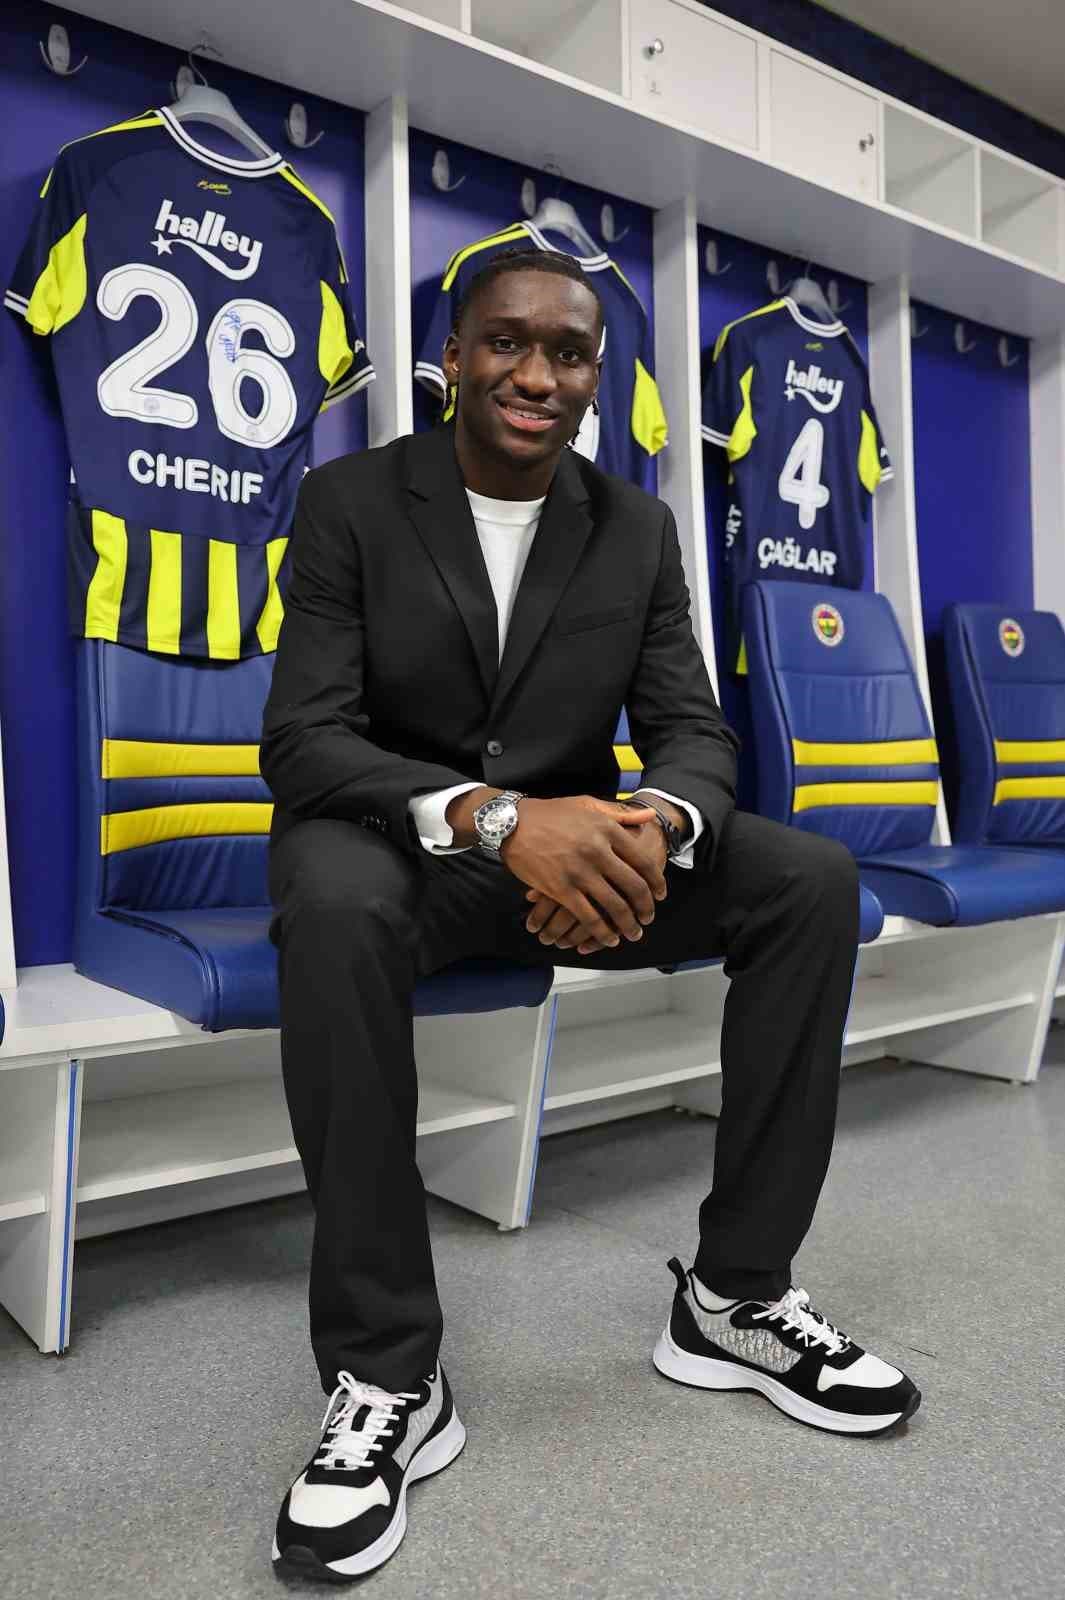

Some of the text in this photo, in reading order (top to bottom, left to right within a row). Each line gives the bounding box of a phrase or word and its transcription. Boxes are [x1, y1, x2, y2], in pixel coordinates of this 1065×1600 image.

[153, 199, 263, 281] halley
[96, 262, 298, 450] 26
[784, 359, 844, 414] halley
[127, 449, 264, 504] CHERIF
[778, 418, 830, 530] 4
[757, 536, 838, 576] ÇAĞLAR
